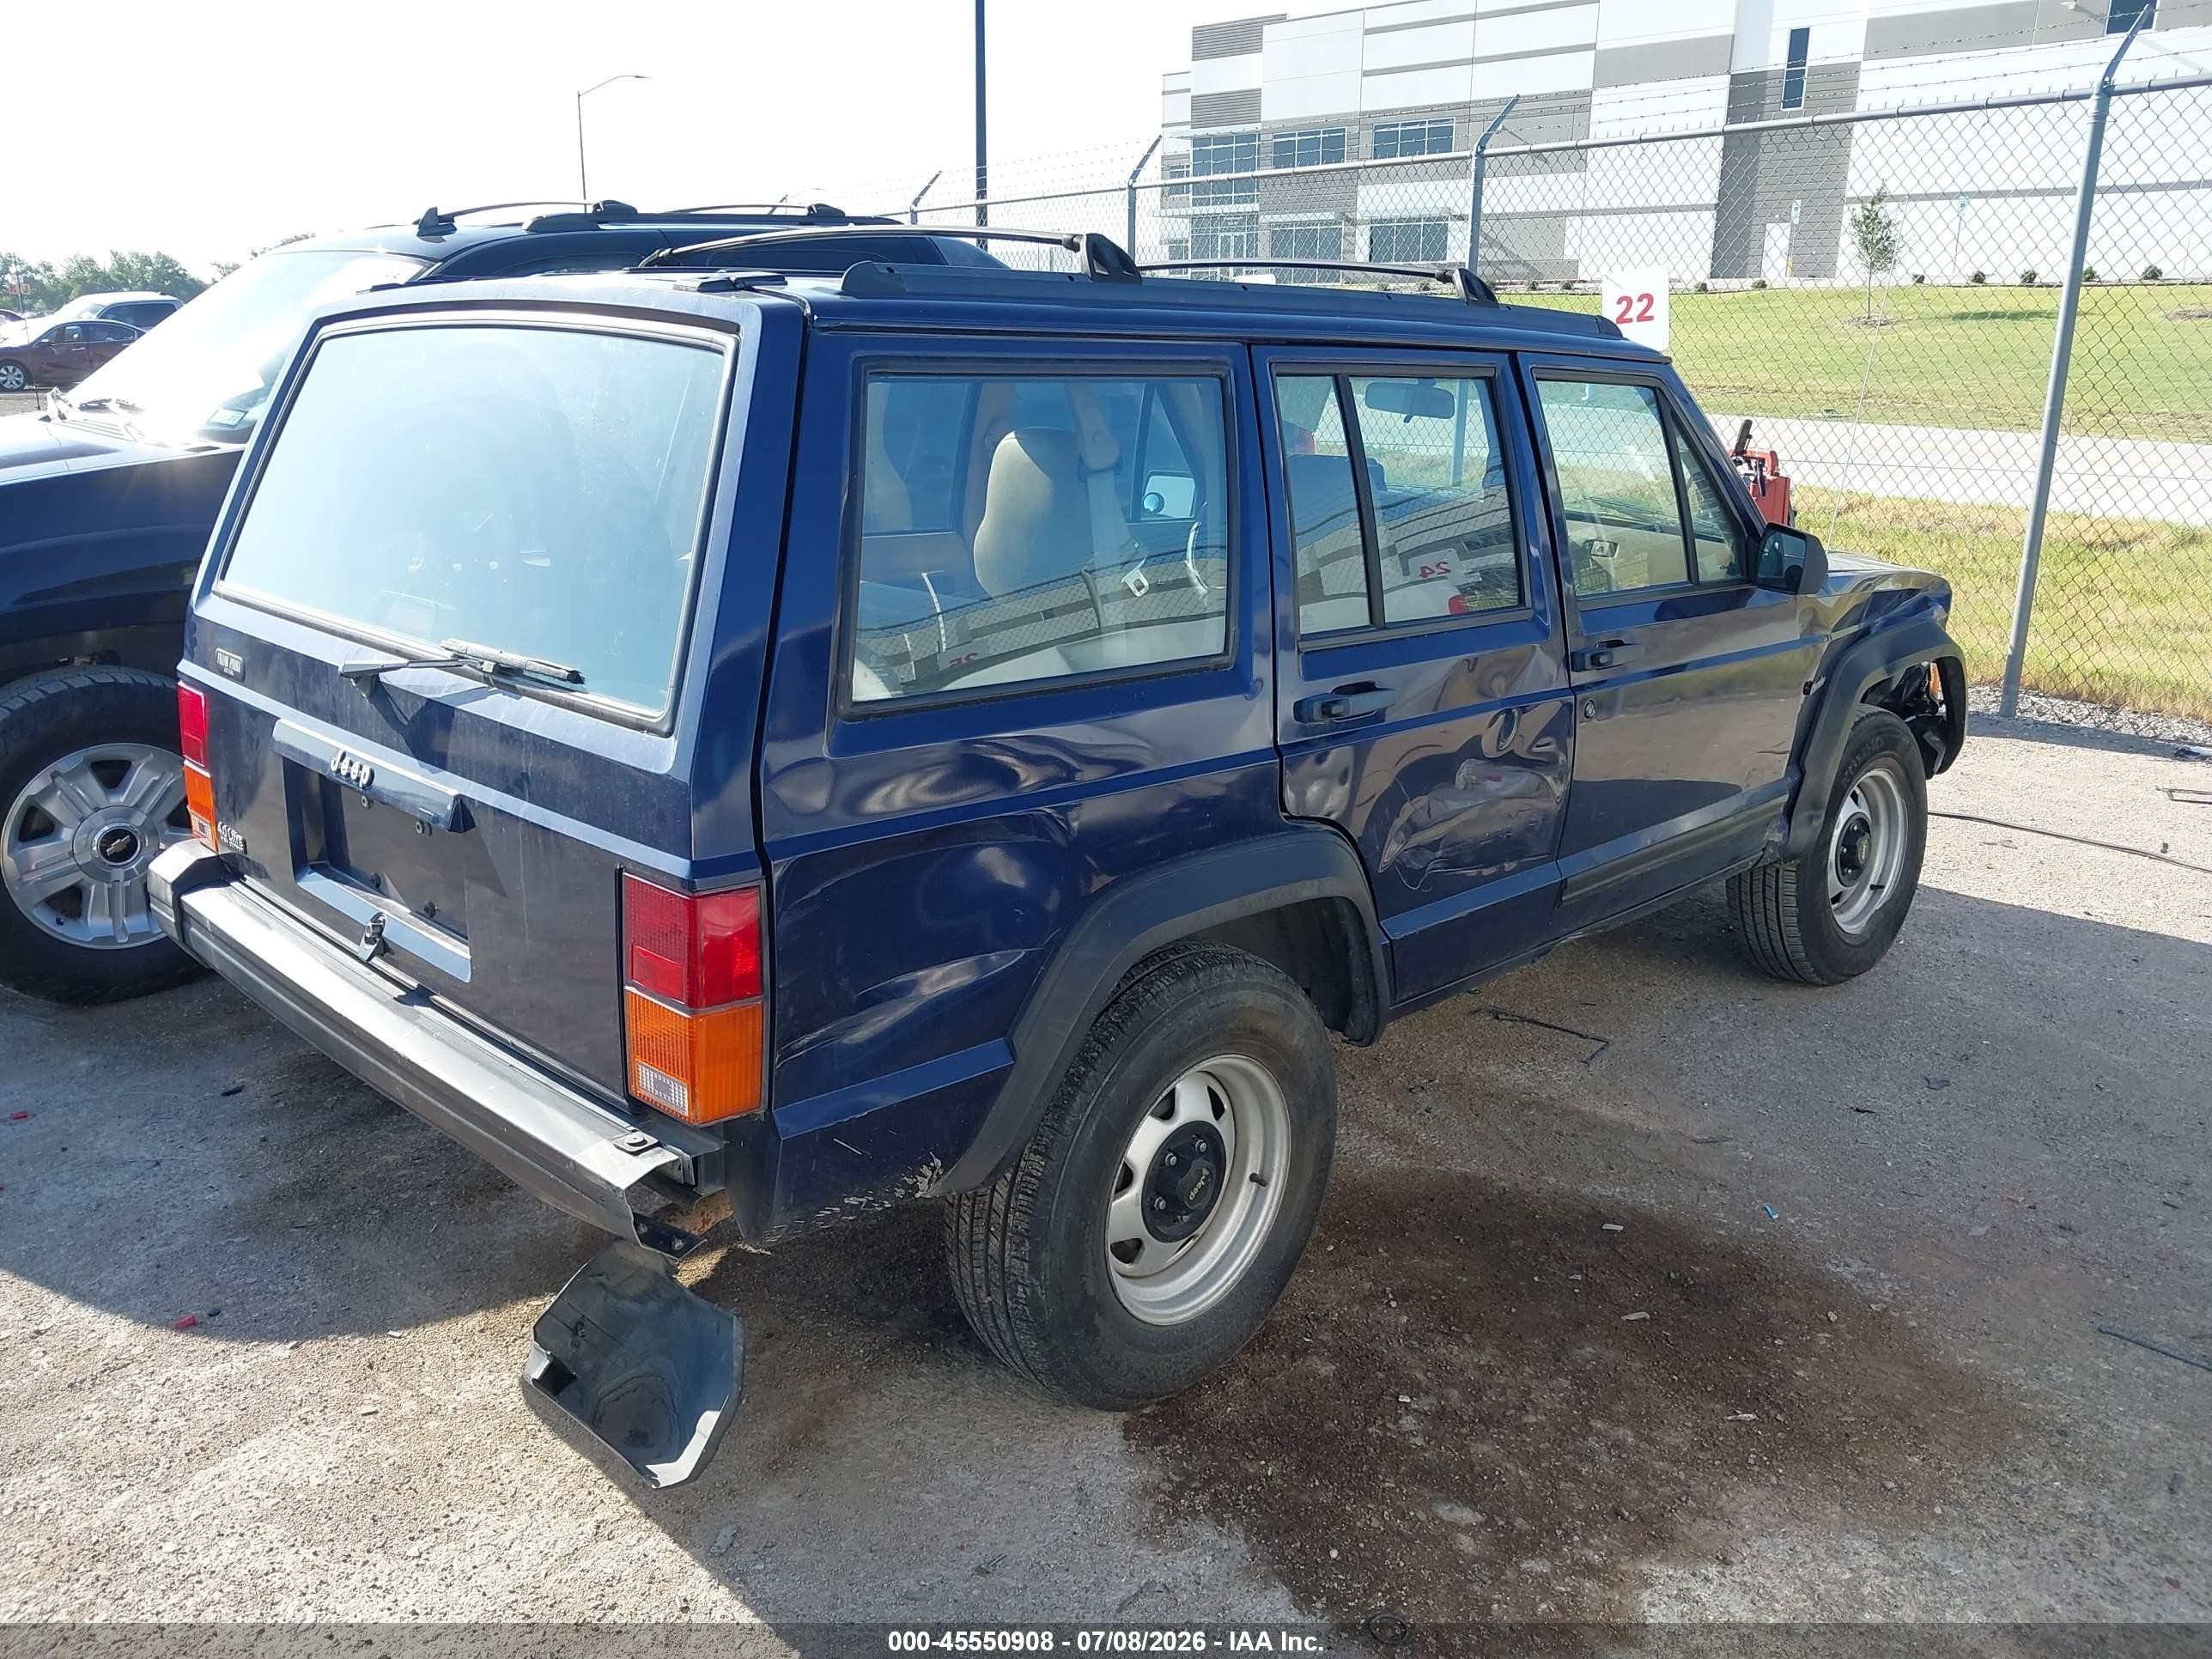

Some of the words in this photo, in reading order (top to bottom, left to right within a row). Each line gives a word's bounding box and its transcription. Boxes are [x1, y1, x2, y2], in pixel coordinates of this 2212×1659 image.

[1615, 293, 1655, 325] 22
[330, 749, 371, 788] Jeep
[1188, 1175, 1206, 1200] Jeep
